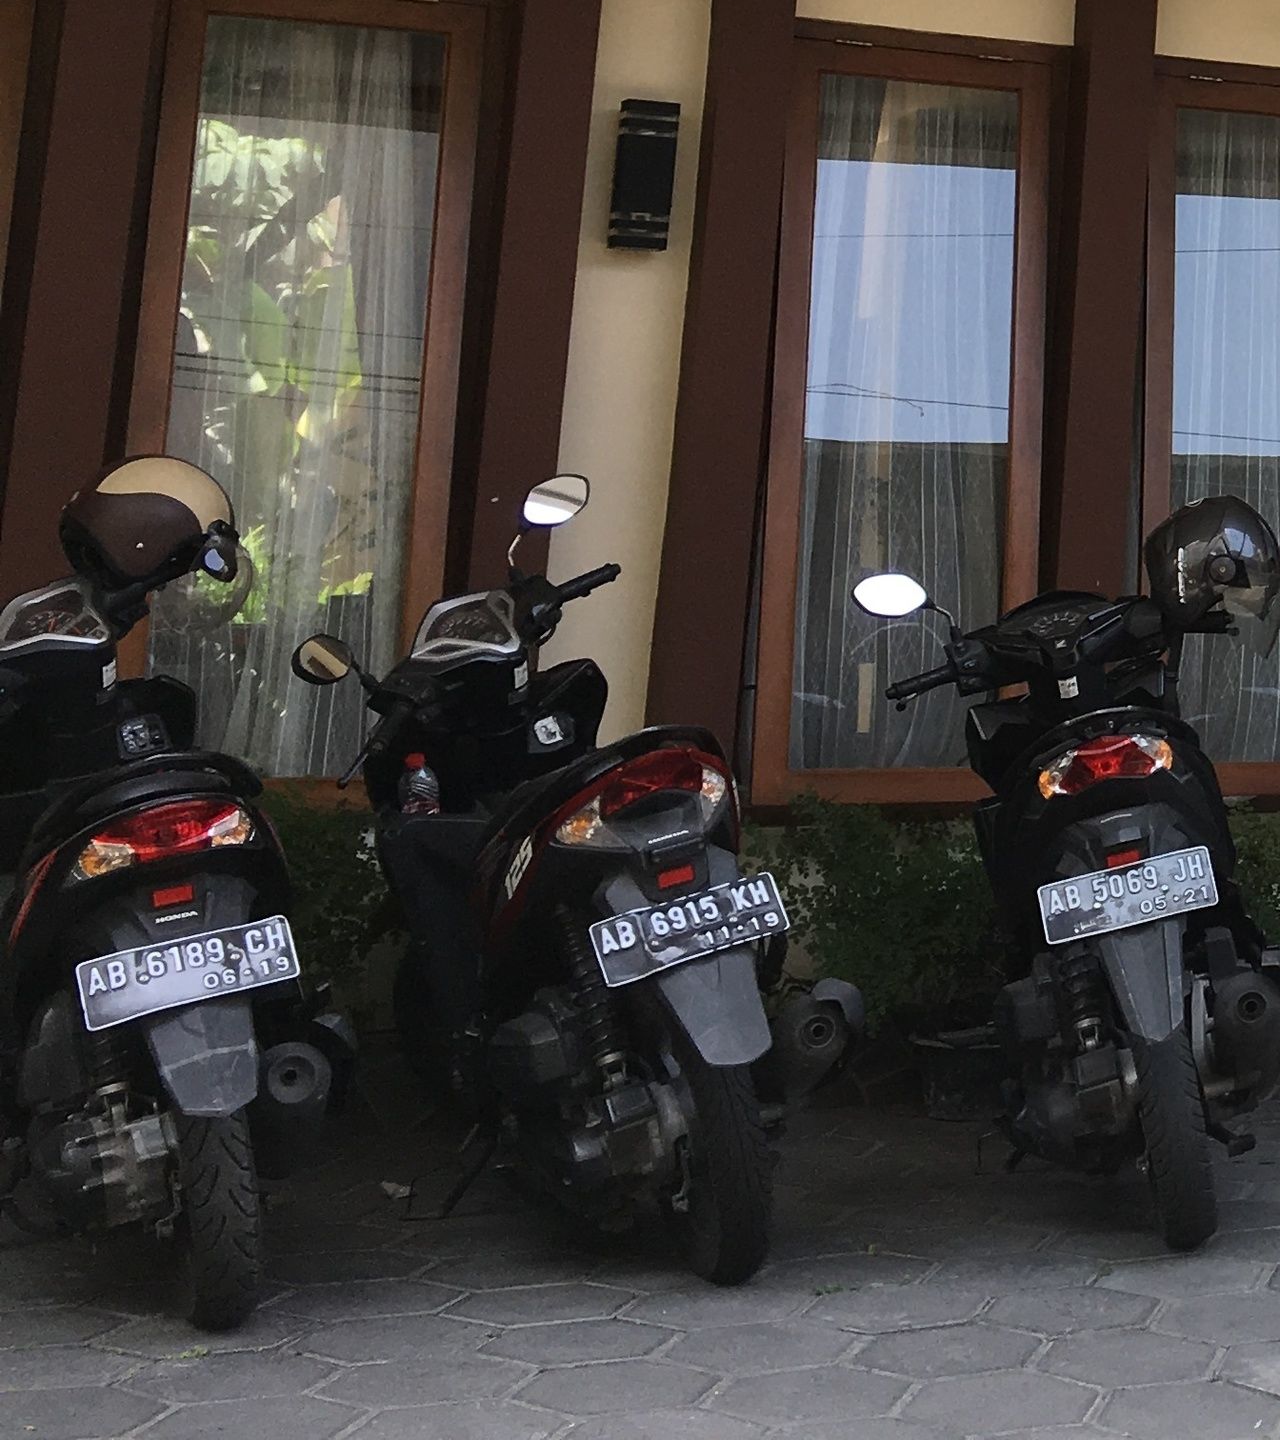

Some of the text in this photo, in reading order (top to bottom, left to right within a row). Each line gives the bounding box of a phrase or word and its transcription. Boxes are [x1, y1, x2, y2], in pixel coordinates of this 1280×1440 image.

[504, 835, 533, 900] 125
[1050, 854, 1204, 914] AB 5069 JH
[155, 910, 199, 924] HONDA
[601, 880, 770, 955] AB 6915 KH
[89, 923, 286, 996] AB 6189 CH
